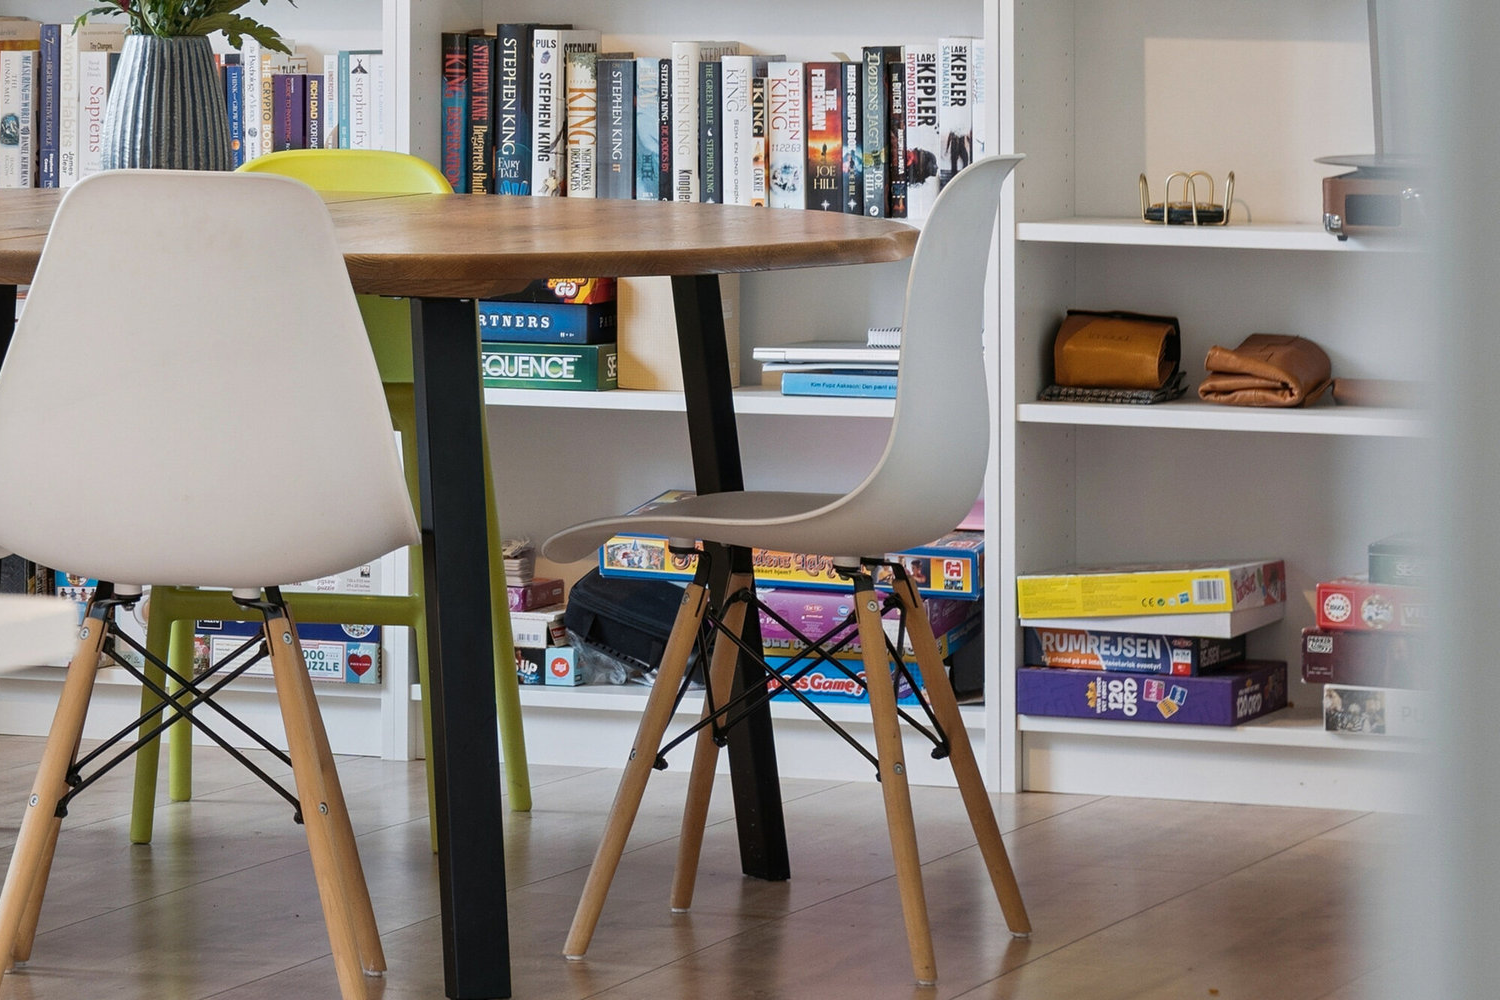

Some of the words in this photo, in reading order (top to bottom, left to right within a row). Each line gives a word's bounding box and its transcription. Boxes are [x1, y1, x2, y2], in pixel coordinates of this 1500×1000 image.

[63, 34, 75, 91] Atomic
[535, 38, 557, 50] PULS
[916, 53, 936, 62] LARS
[951, 45, 967, 53] LARS
[20, 55, 32, 92] MEASURING
[262, 60, 271, 78] THE
[444, 53, 468, 98] KING
[471, 44, 489, 92] STEPHEN
[502, 37, 518, 109] STEPHEN
[677, 54, 690, 114] STEPHEN
[705, 64, 714, 78] THE
[864, 51, 882, 112] DØDENS
[942, 45, 950, 107] SANDMANDEN
[950, 53, 967, 107] KEPLER
[262, 81, 271, 121] CRYPTO
[352, 77, 366, 126] stephen
[471, 95, 488, 120] KING
[539, 72, 552, 129] STEPHEN
[612, 70, 622, 125] STEPHEN
[705, 79, 713, 103] GREEN
[726, 69, 739, 113] KING
[739, 68, 747, 112] STEPHEN
[771, 78, 788, 131] KING
[787, 69, 801, 141] STEPHEN
[811, 68, 826, 131] FIREMAN
[826, 88, 837, 111] THE
[906, 53, 916, 128] HYPNOTISØREN
[916, 62, 937, 127] KEPLER
[20, 102, 31, 124] WORLD
[63, 98, 76, 148] Habits
[85, 86, 104, 152] Sapiens
[568, 87, 597, 146] KING
[705, 104, 713, 125] MILE
[753, 87, 765, 134] KING
[262, 124, 271, 154] BOOK
[353, 129, 367, 148] fry
[501, 113, 516, 156] KING
[537, 131, 551, 163] KING
[612, 128, 623, 161] KING
[677, 119, 690, 156] KING
[866, 114, 880, 148] JAGT
[570, 147, 581, 192] DREAMSCAPES
[612, 163, 621, 173] IT
[705, 138, 714, 170] STEPHEN
[815, 165, 836, 176] JOE
[705, 172, 714, 193] KING
[753, 168, 764, 192] CARRIE
[813, 177, 837, 190] HILL
[864, 173, 875, 203] HILL
[873, 168, 884, 190] JOE
[555, 282, 577, 298] GO
[1041, 632, 1162, 660] RUMREJSEN
[1053, 657, 1071, 665] afsted
[1073, 658, 1081, 667] på
[1108, 679, 1124, 711] 120
[1123, 677, 1138, 717] ORD
